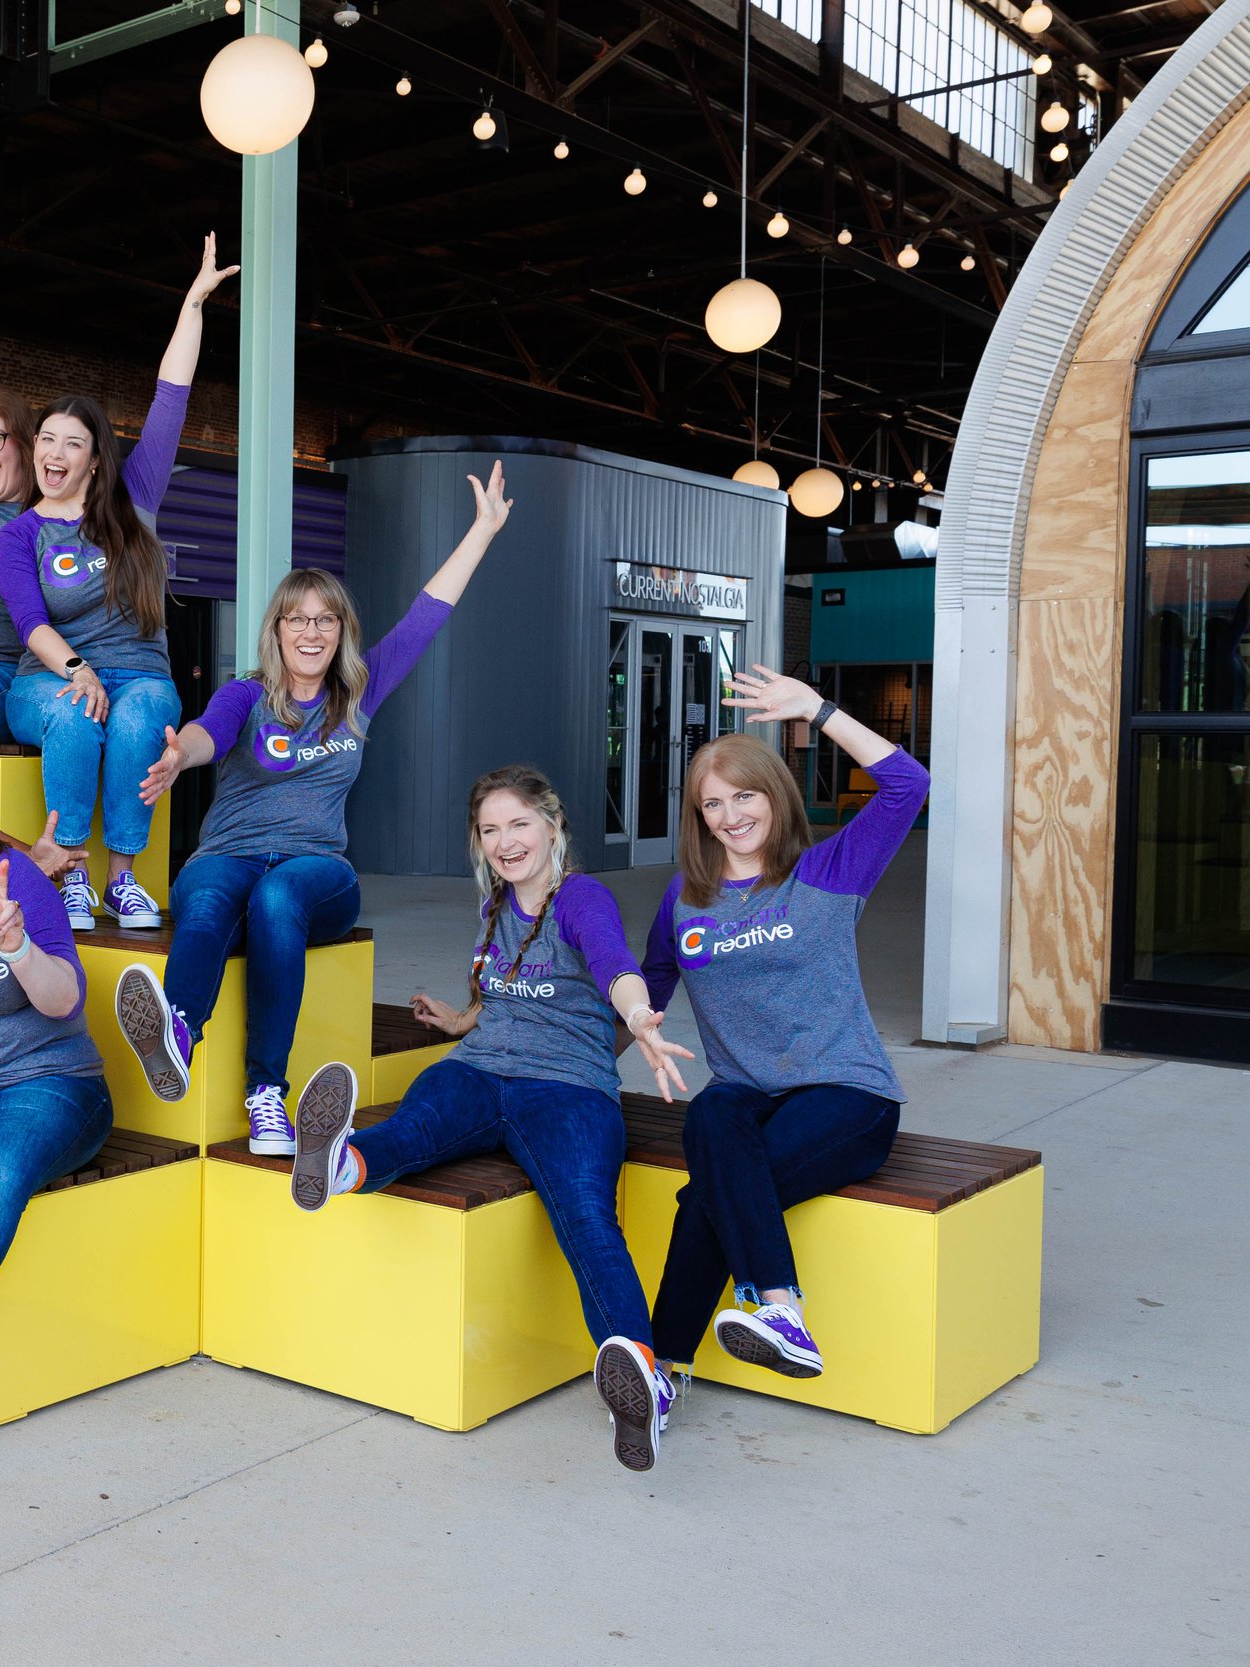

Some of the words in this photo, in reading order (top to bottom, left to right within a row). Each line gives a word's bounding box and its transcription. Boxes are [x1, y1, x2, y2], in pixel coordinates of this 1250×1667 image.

[618, 572, 679, 602] CURRENT
[679, 580, 744, 610] NOSTALGIA
[266, 735, 357, 762] Creative
[680, 923, 793, 956] Creative
